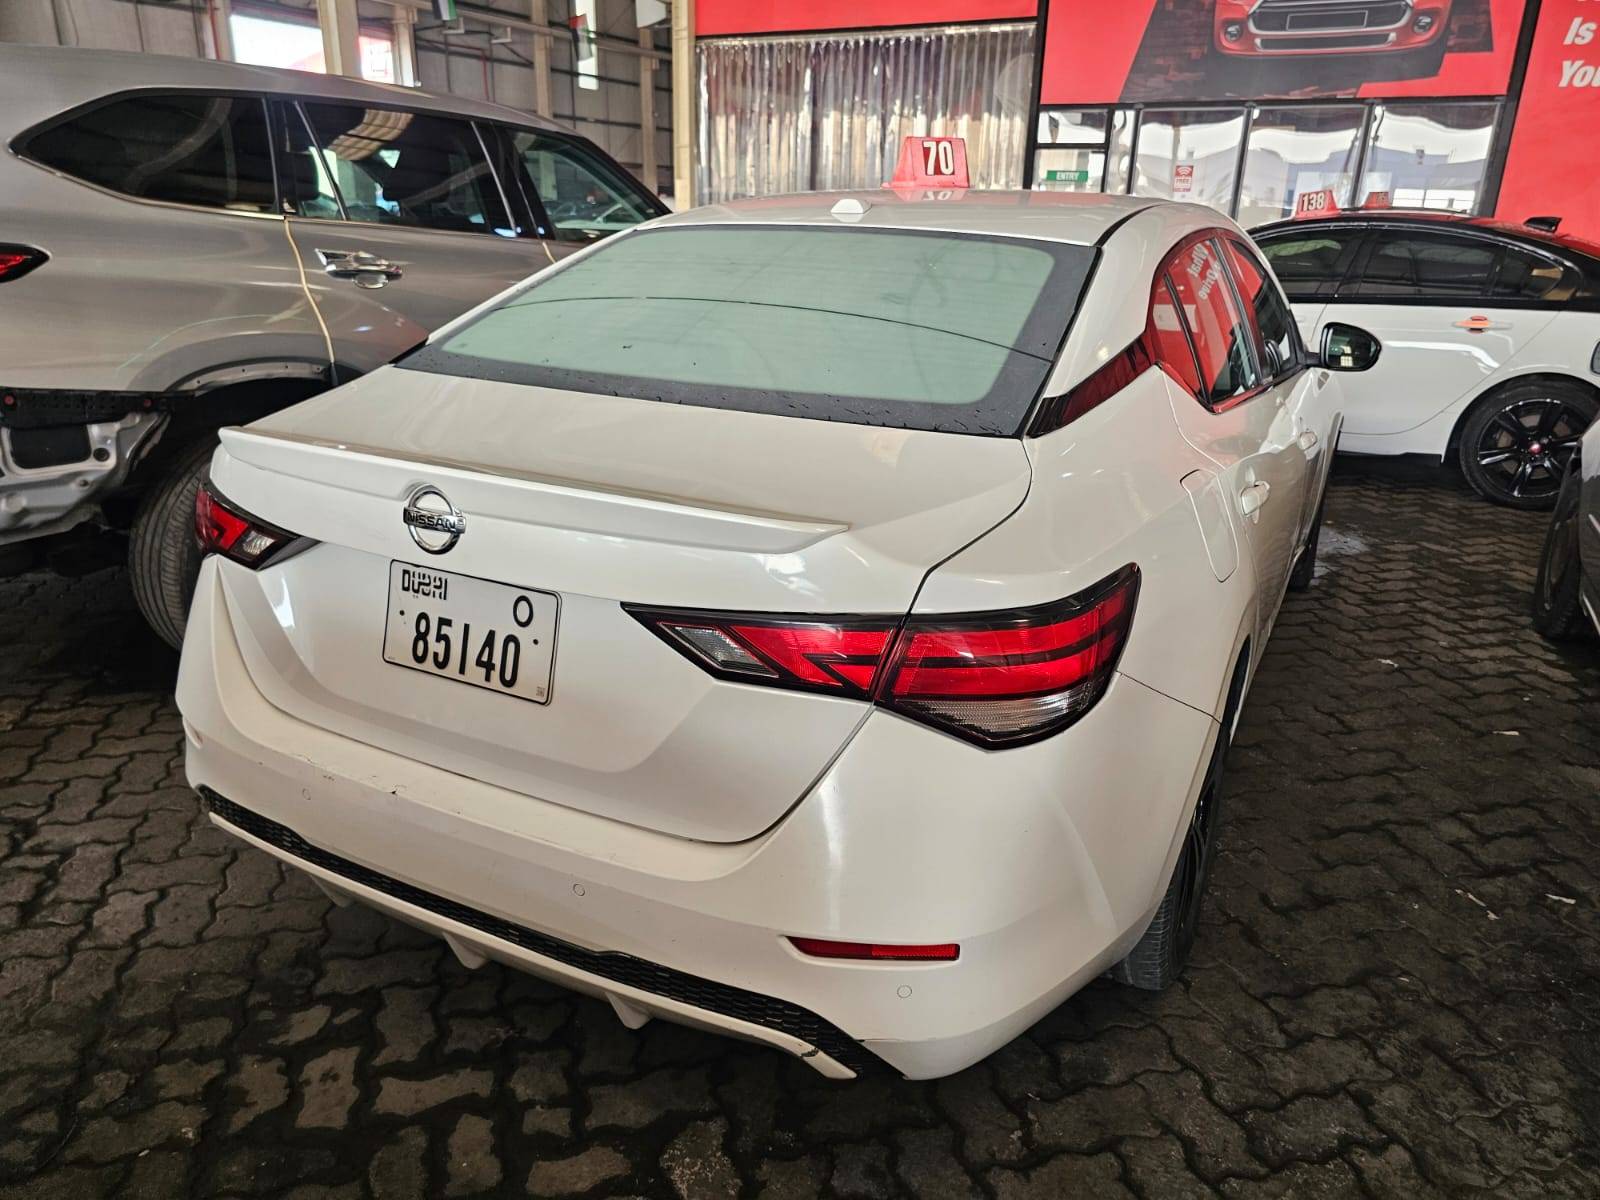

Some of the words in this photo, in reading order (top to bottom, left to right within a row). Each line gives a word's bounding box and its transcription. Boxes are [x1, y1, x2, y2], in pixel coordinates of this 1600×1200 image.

[1563, 16, 1597, 46] Is
[923, 141, 954, 175] 70
[1056, 171, 1080, 181] ENTRY
[1302, 192, 1324, 211] 138
[407, 511, 456, 530] NISSAN
[412, 612, 521, 688] 85140
